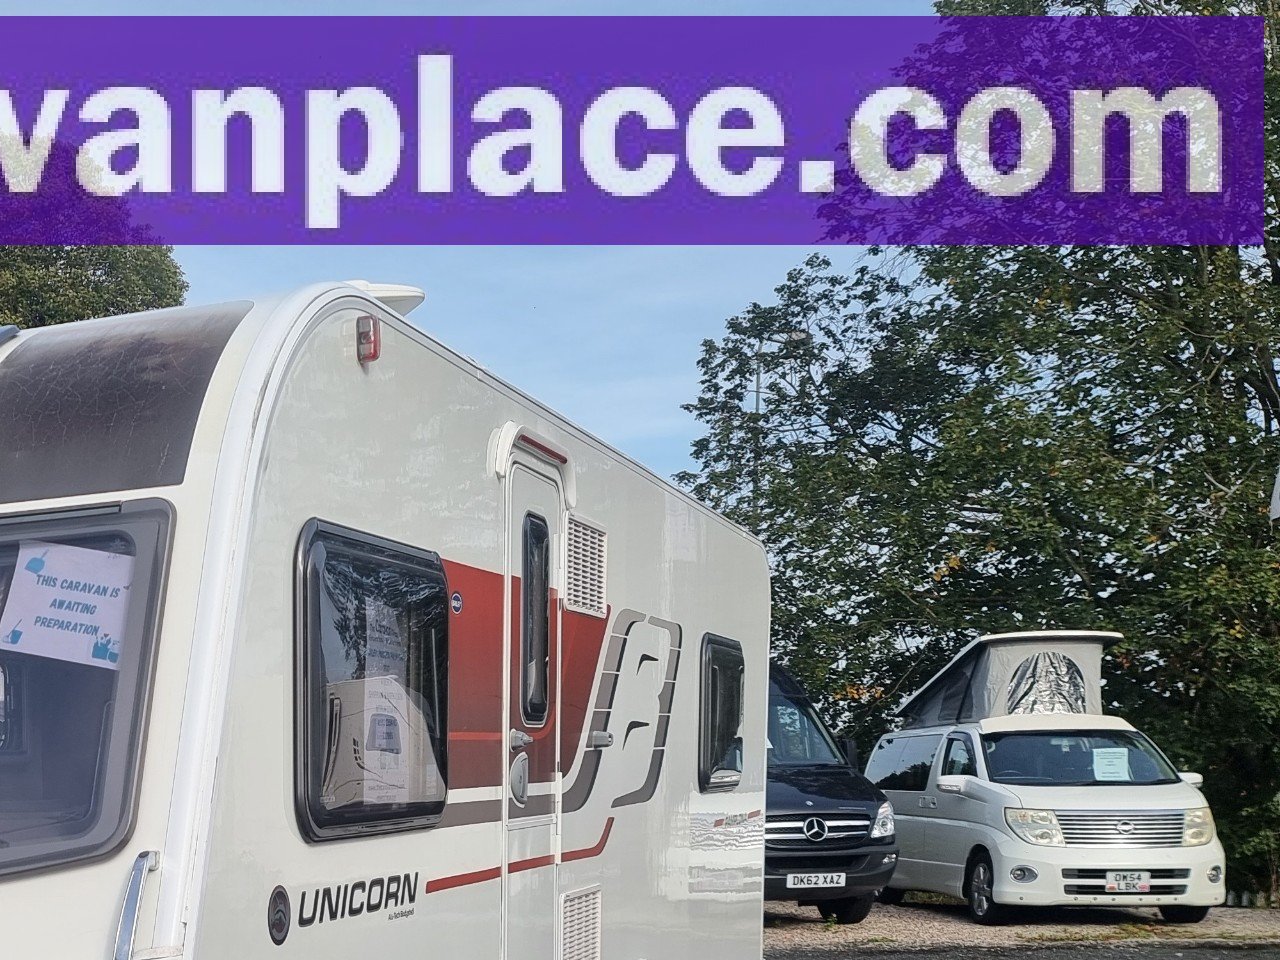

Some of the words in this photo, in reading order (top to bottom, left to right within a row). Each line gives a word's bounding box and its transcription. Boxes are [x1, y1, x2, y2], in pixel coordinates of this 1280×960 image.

[36, 574, 58, 588] THIS
[60, 579, 109, 597] CARAVAN
[110, 587, 121, 598] IS
[49, 598, 97, 615] AWAITING
[34, 616, 100, 636] PREPARATION
[792, 875, 820, 886] DK62
[821, 874, 842, 885] XAZ
[298, 871, 419, 928] UNICORN
